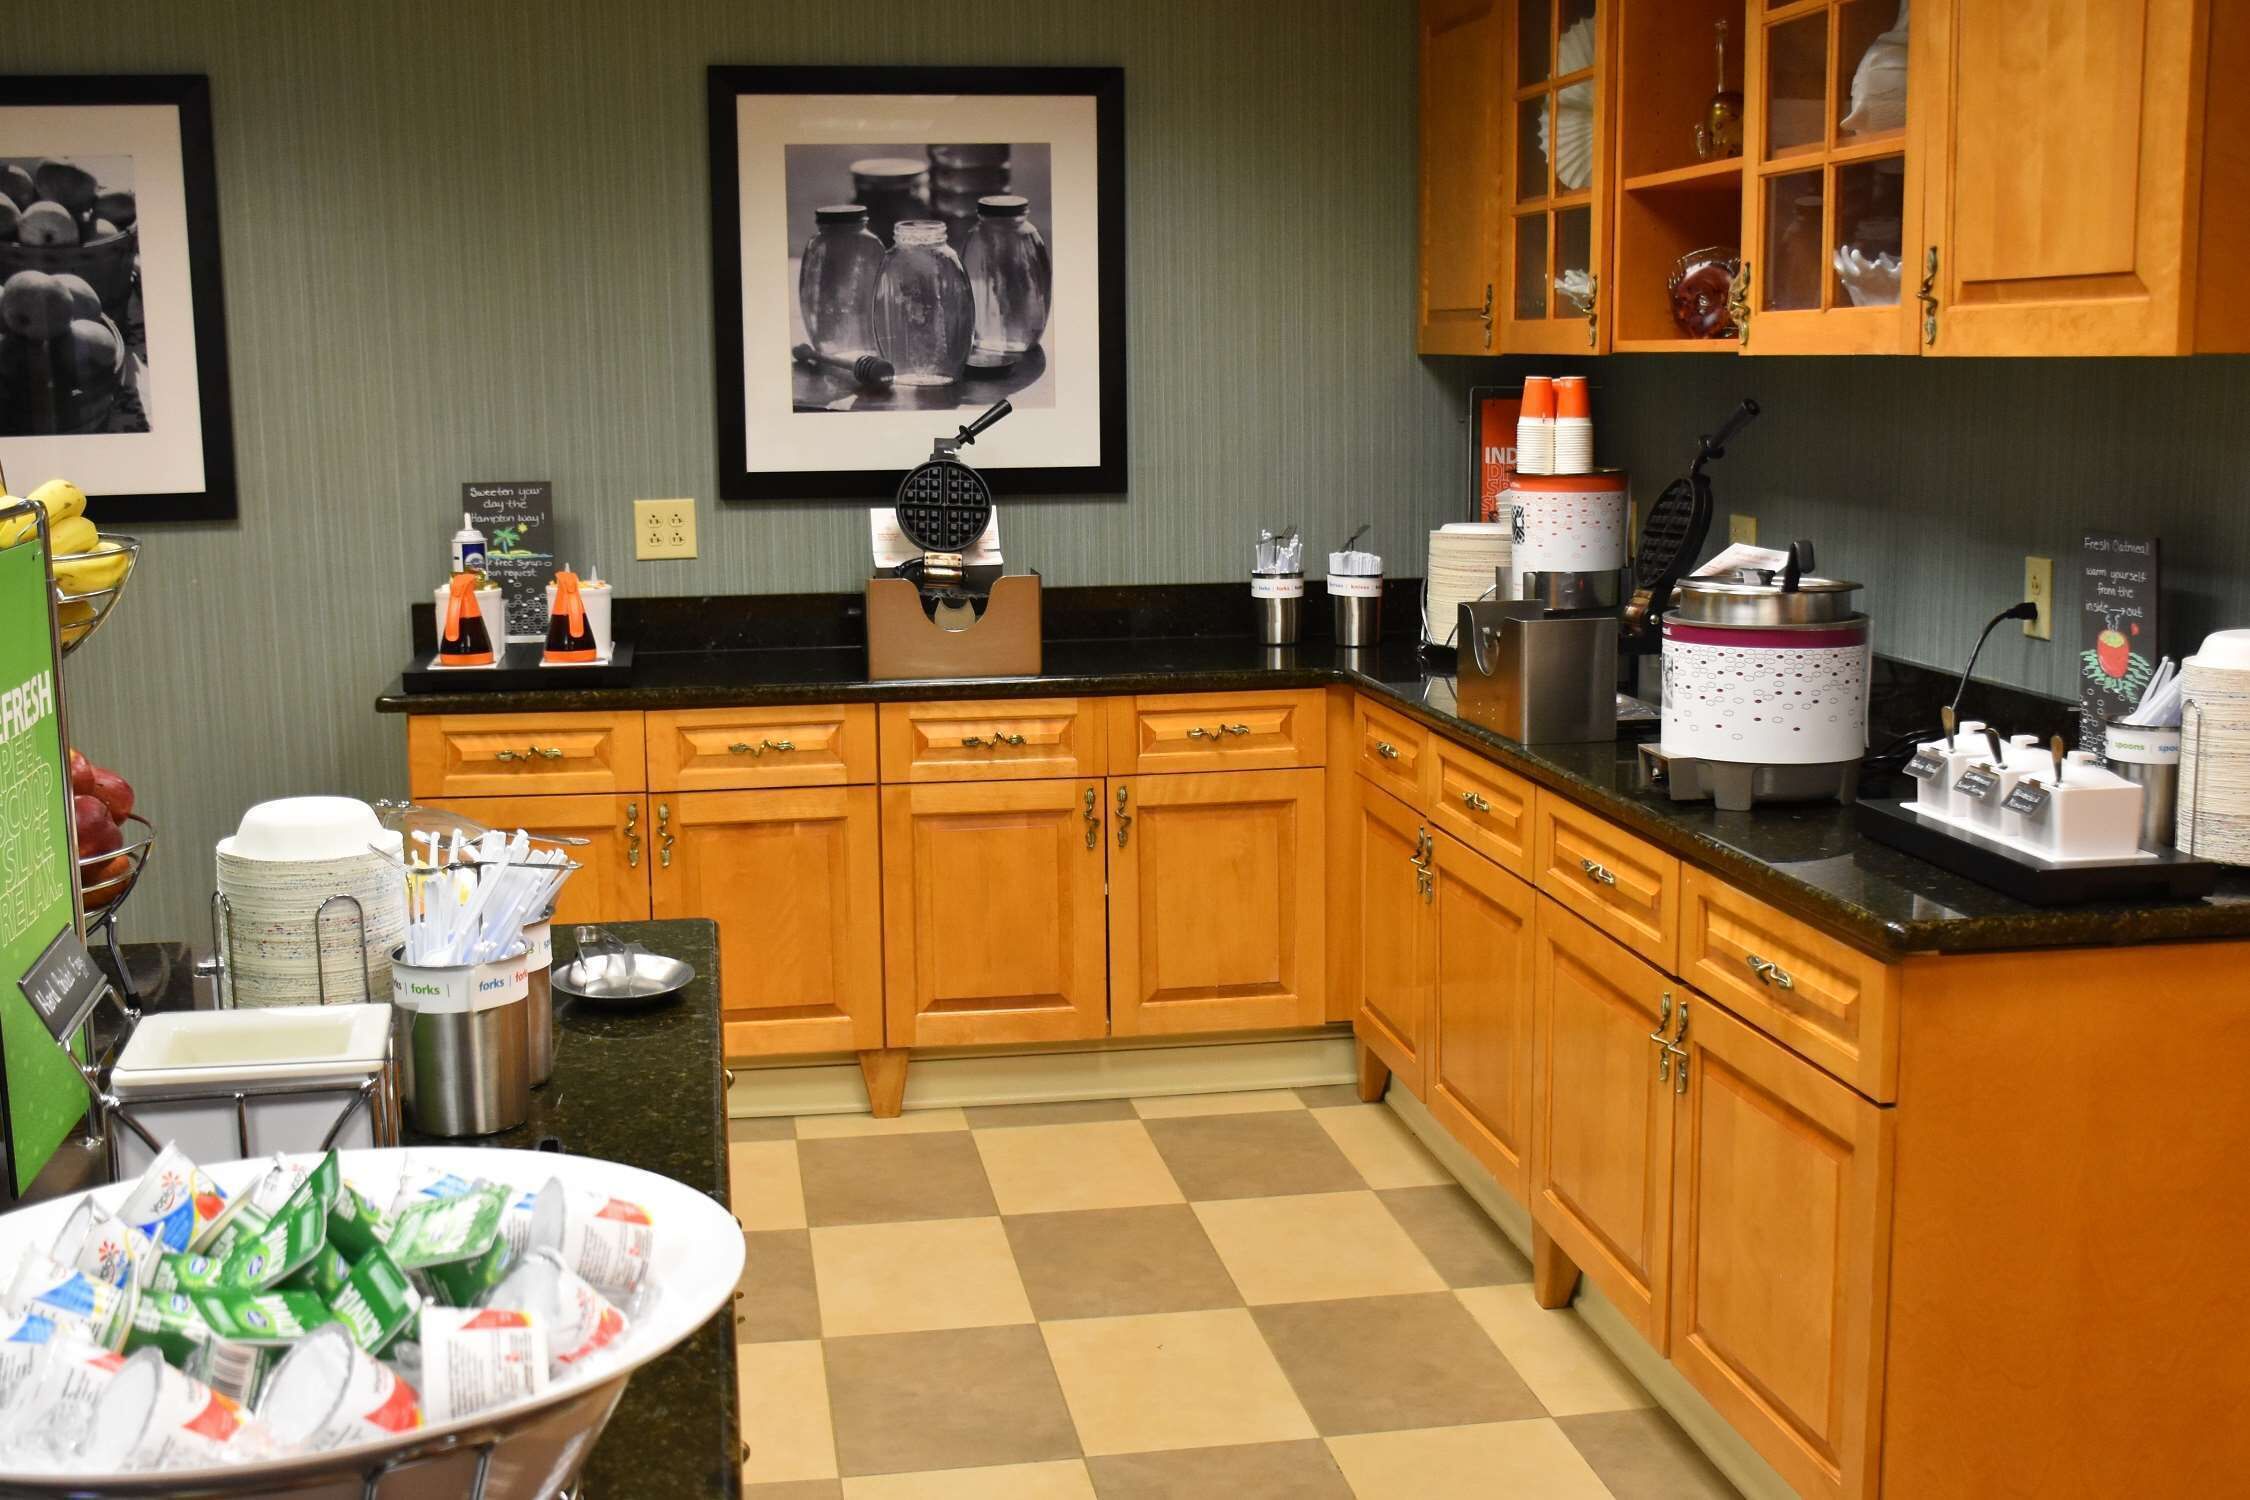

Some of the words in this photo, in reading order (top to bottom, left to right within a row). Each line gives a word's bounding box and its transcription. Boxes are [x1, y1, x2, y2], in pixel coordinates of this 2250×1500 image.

[470, 487, 514, 498] Sweeten
[518, 488, 543, 501] your
[483, 500, 504, 513] day
[506, 500, 527, 509] the
[471, 513, 515, 524] Hampton
[2084, 537, 2110, 552] Fresh
[2112, 539, 2150, 556] Oatmeal
[2110, 571, 2148, 585] yourself
[2096, 582, 2117, 596] from
[2117, 586, 2134, 598] the
[411, 983, 440, 996] forks
[479, 977, 504, 993] forks
